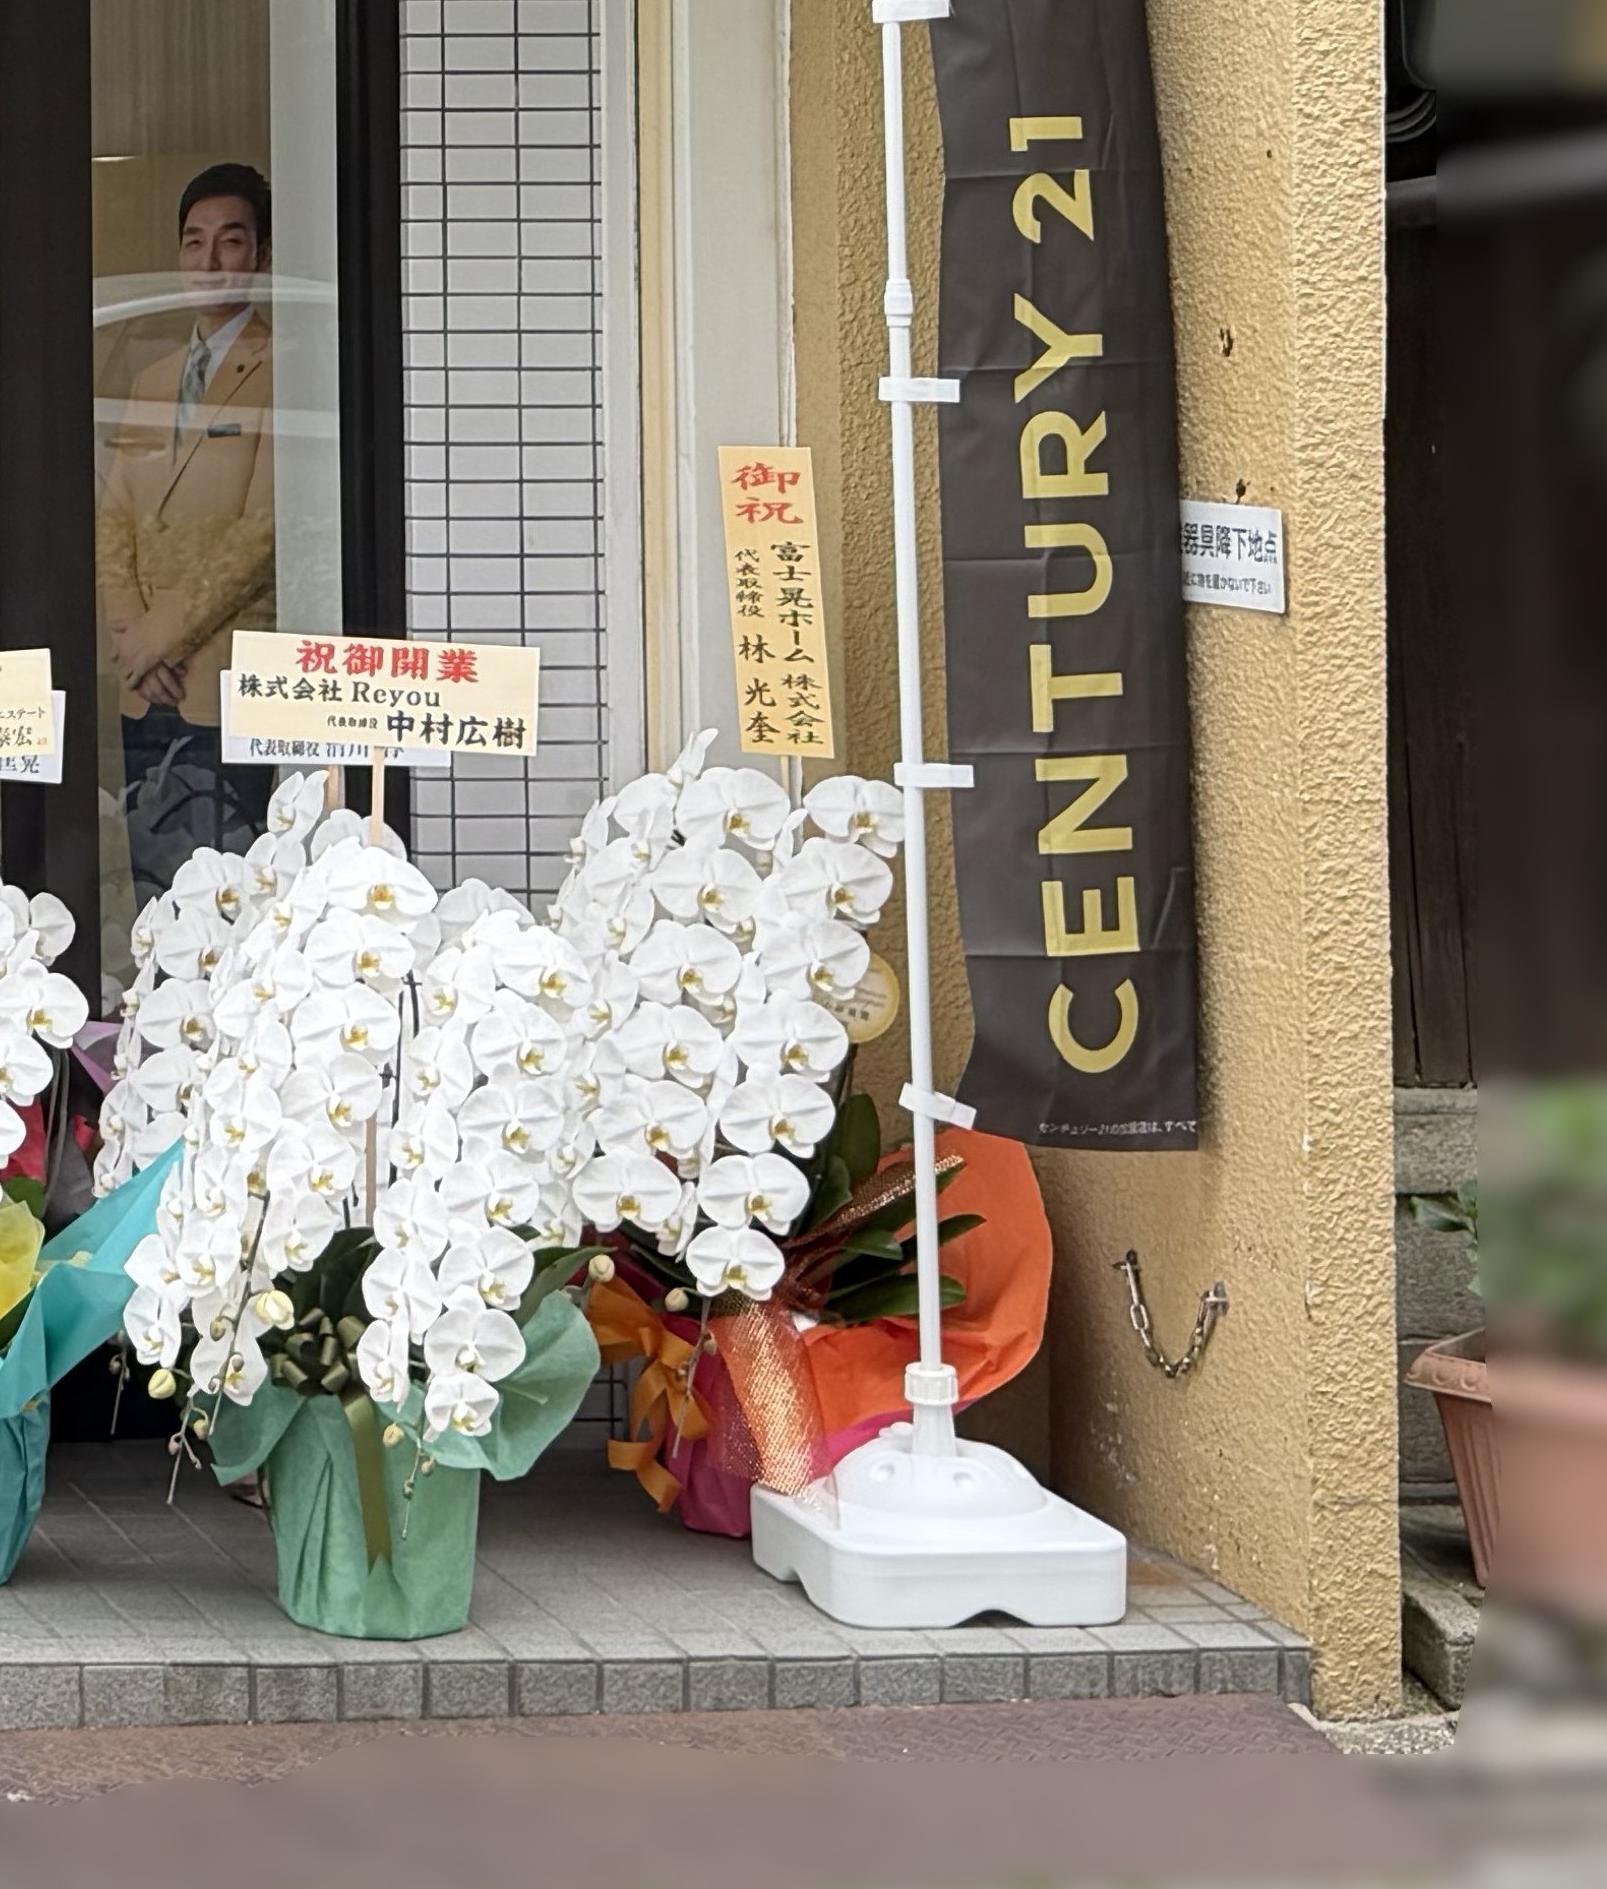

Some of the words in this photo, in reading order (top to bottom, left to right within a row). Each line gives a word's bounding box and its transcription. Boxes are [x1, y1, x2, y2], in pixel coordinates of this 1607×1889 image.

[1010, 117, 1096, 245] 21
[731, 461, 804, 525] 御祝
[734, 548, 765, 618] 代表取締役
[296, 639, 480, 684] 祝御開業
[738, 633, 776, 664] 林
[238, 673, 343, 702] 株式会社
[351, 681, 441, 708] Reyou
[781, 673, 825, 745] 株式会社
[1014, 291, 1141, 1075] CENTURY
[250, 737, 320, 758] 代表取締役
[386, 710, 527, 750] 中村広樹
